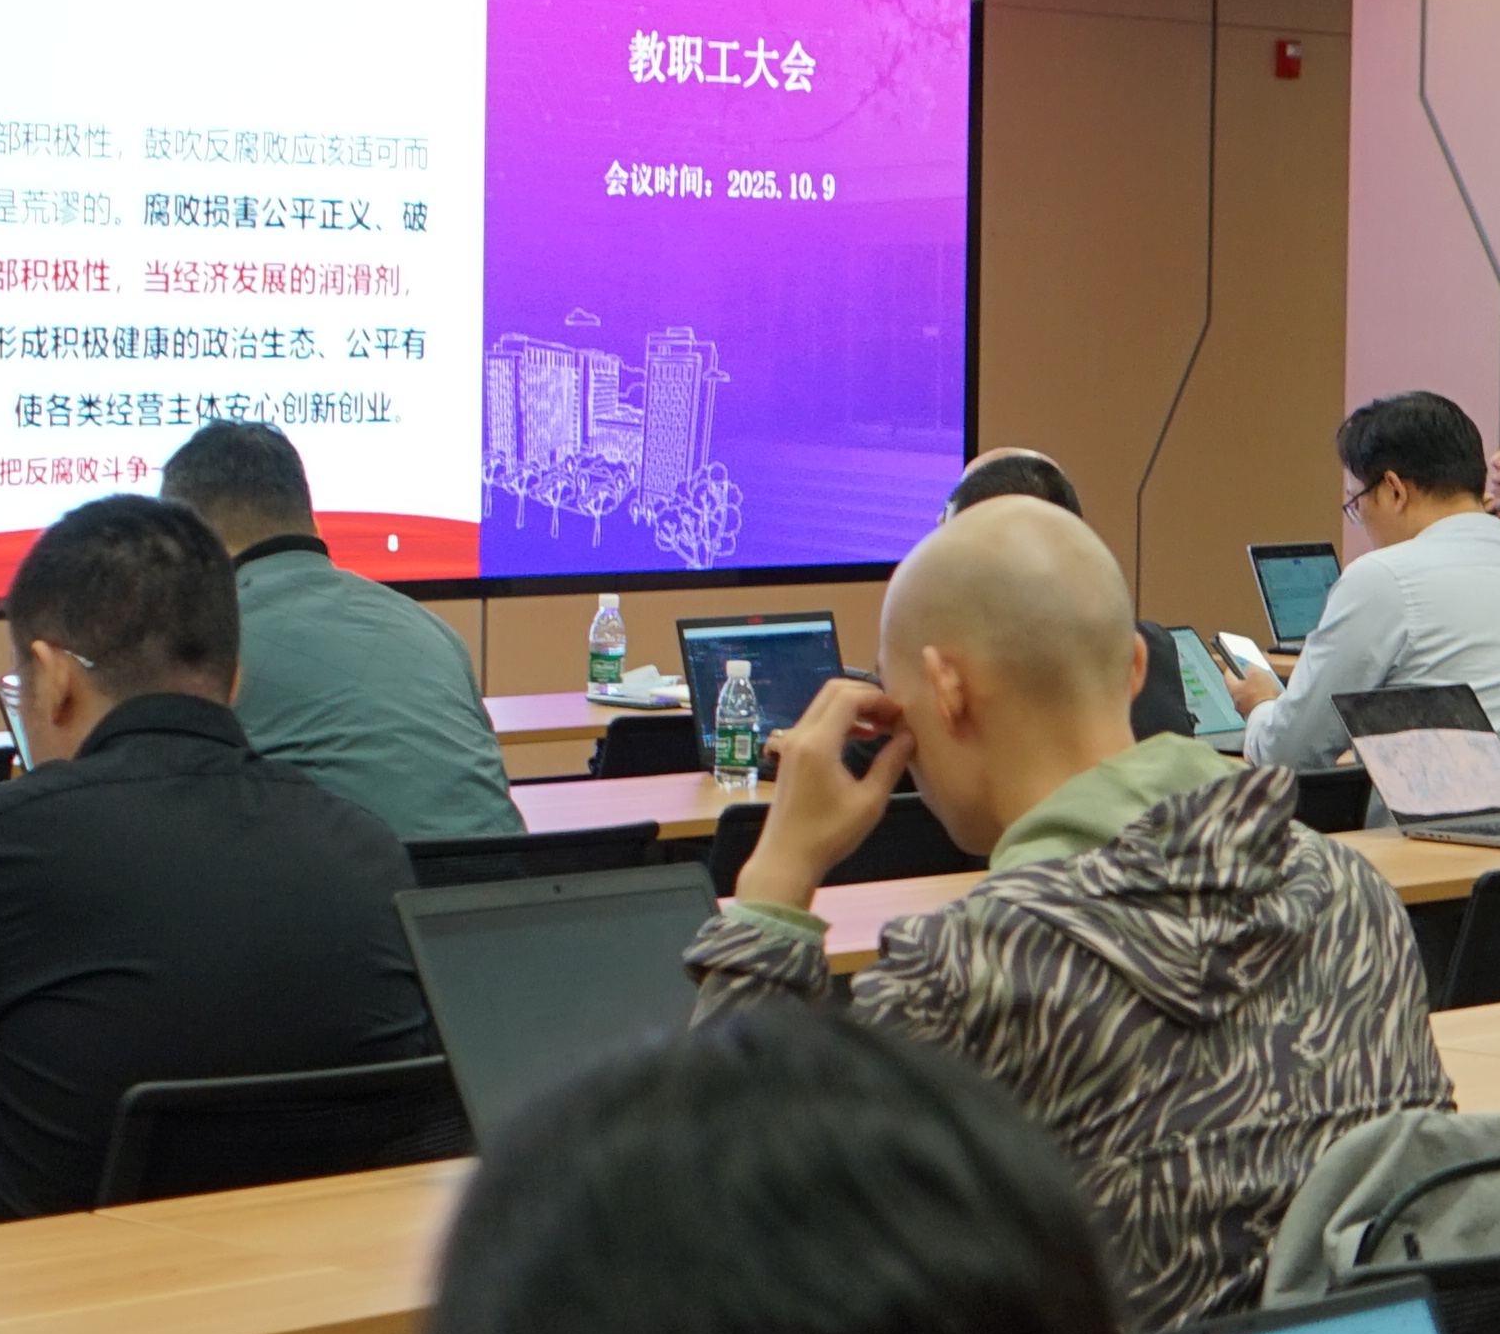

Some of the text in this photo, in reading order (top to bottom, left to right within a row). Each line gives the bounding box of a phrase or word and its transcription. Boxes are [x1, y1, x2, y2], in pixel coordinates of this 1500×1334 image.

[628, 29, 816, 93] 教职工大会
